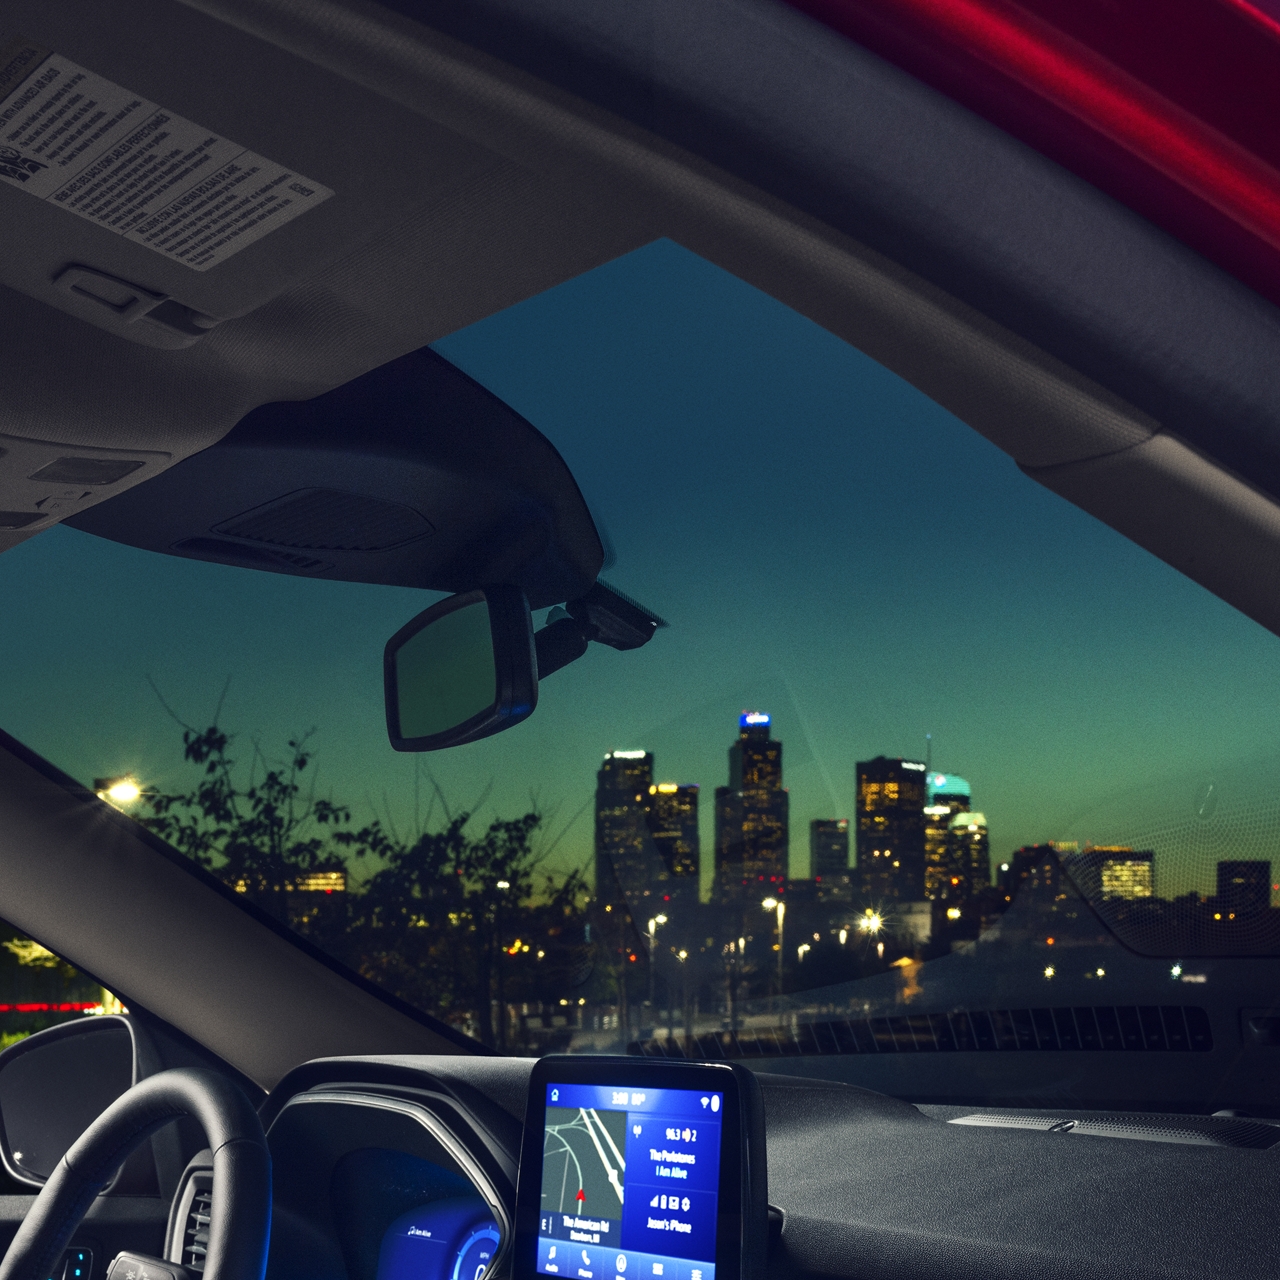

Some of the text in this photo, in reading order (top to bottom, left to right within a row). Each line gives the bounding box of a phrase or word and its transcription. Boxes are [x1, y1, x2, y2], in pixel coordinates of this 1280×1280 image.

[3, 108, 18, 121] WITH
[12, 87, 40, 111] ADVANCED
[33, 79, 48, 90] AIR
[41, 67, 61, 83] BAGS
[157, 210, 173, 220] CON
[168, 204, 182, 213] LAS
[650, 1149, 662, 1161] The
[660, 1166, 670, 1177] Am
[671, 1167, 687, 1179] Alive
